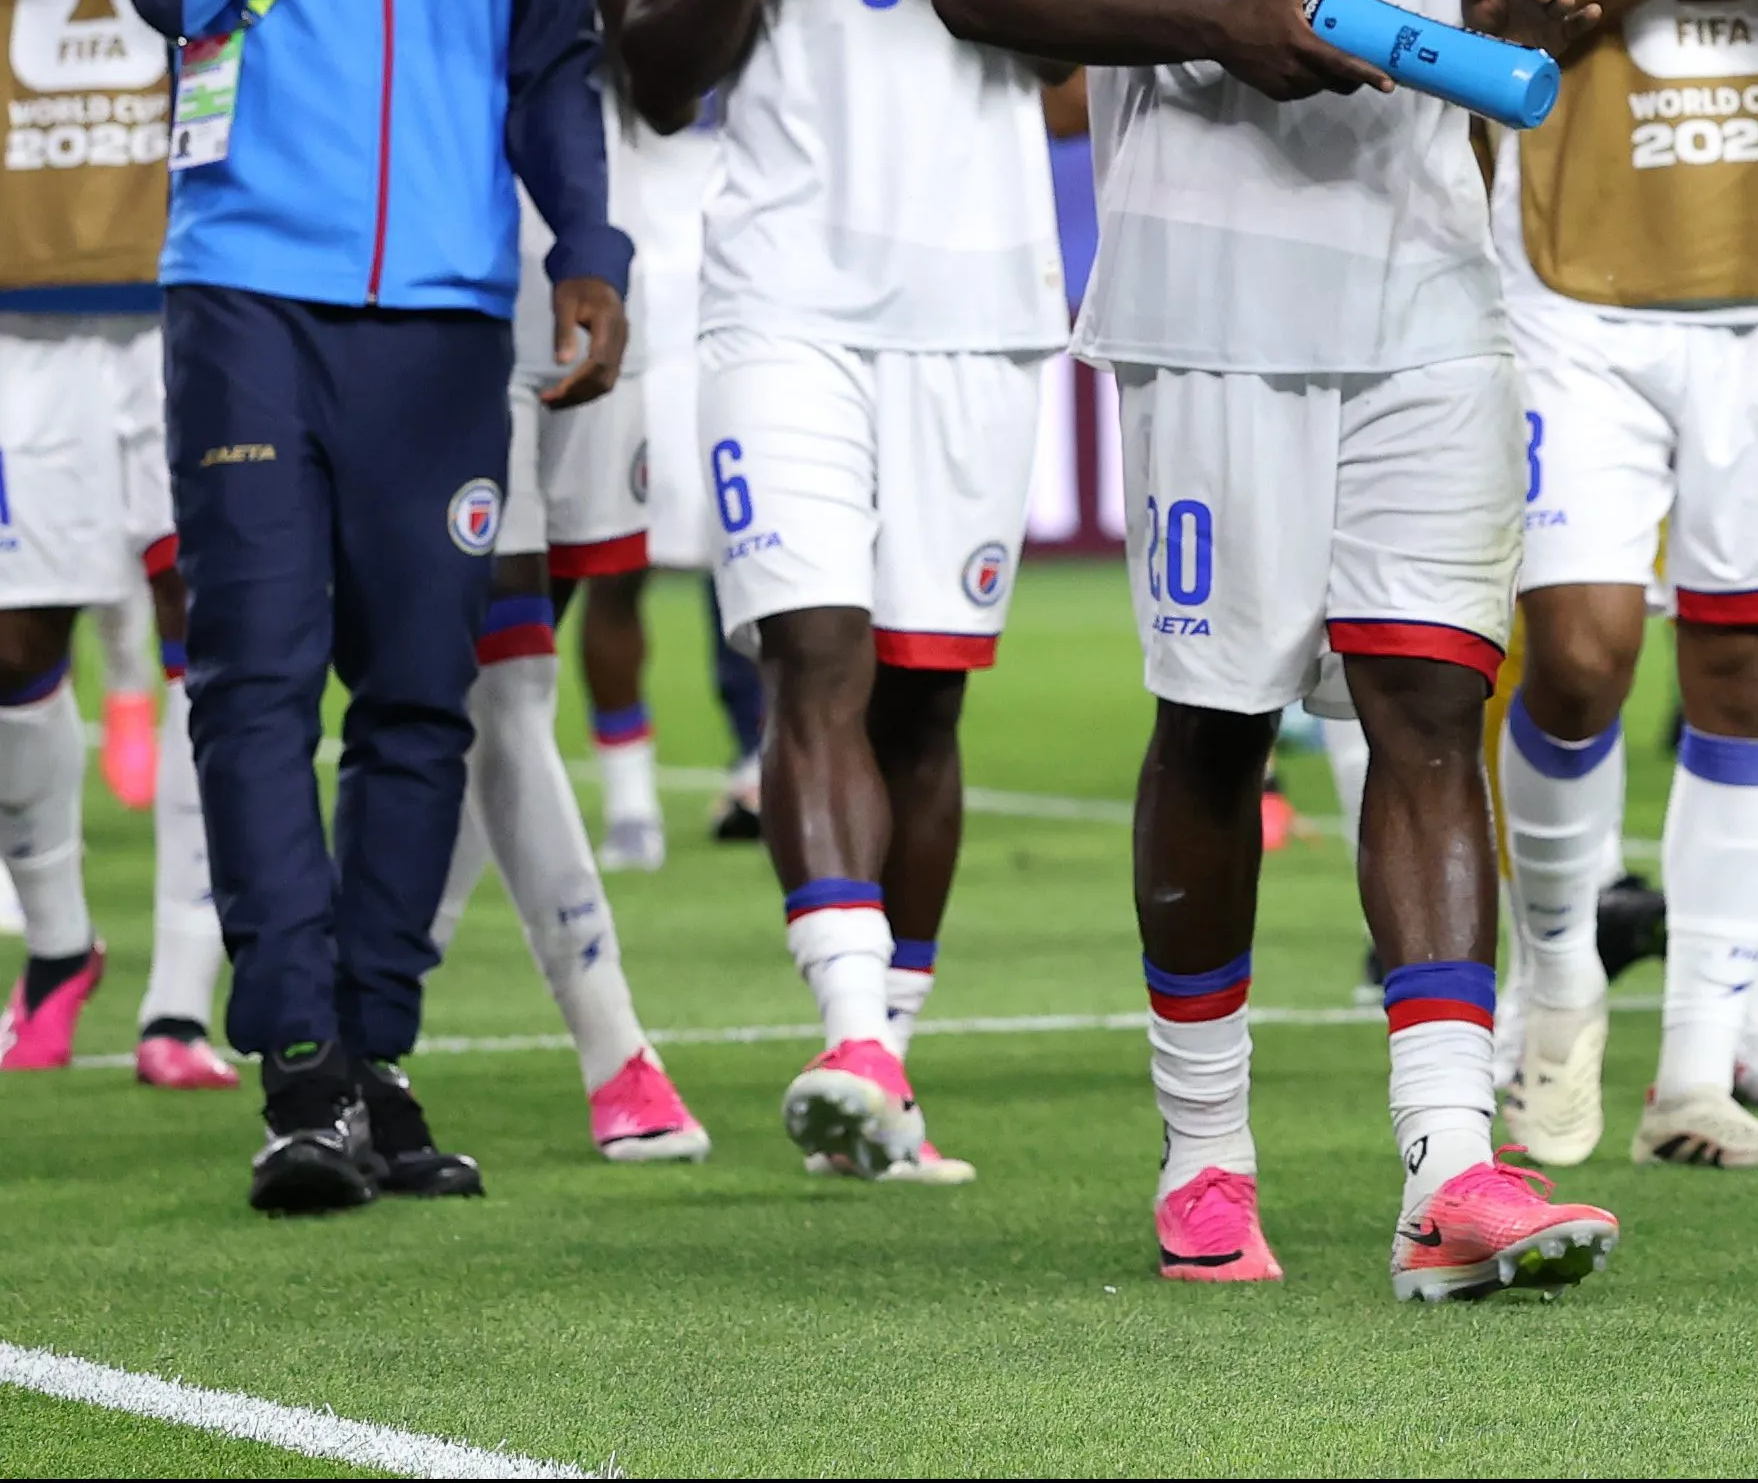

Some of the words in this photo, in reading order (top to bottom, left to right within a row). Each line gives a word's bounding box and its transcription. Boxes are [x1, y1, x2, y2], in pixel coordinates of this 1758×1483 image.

[1676, 17, 1750, 47] FIFA
[1627, 86, 1742, 121] WORLD
[711, 438, 753, 533] 6
